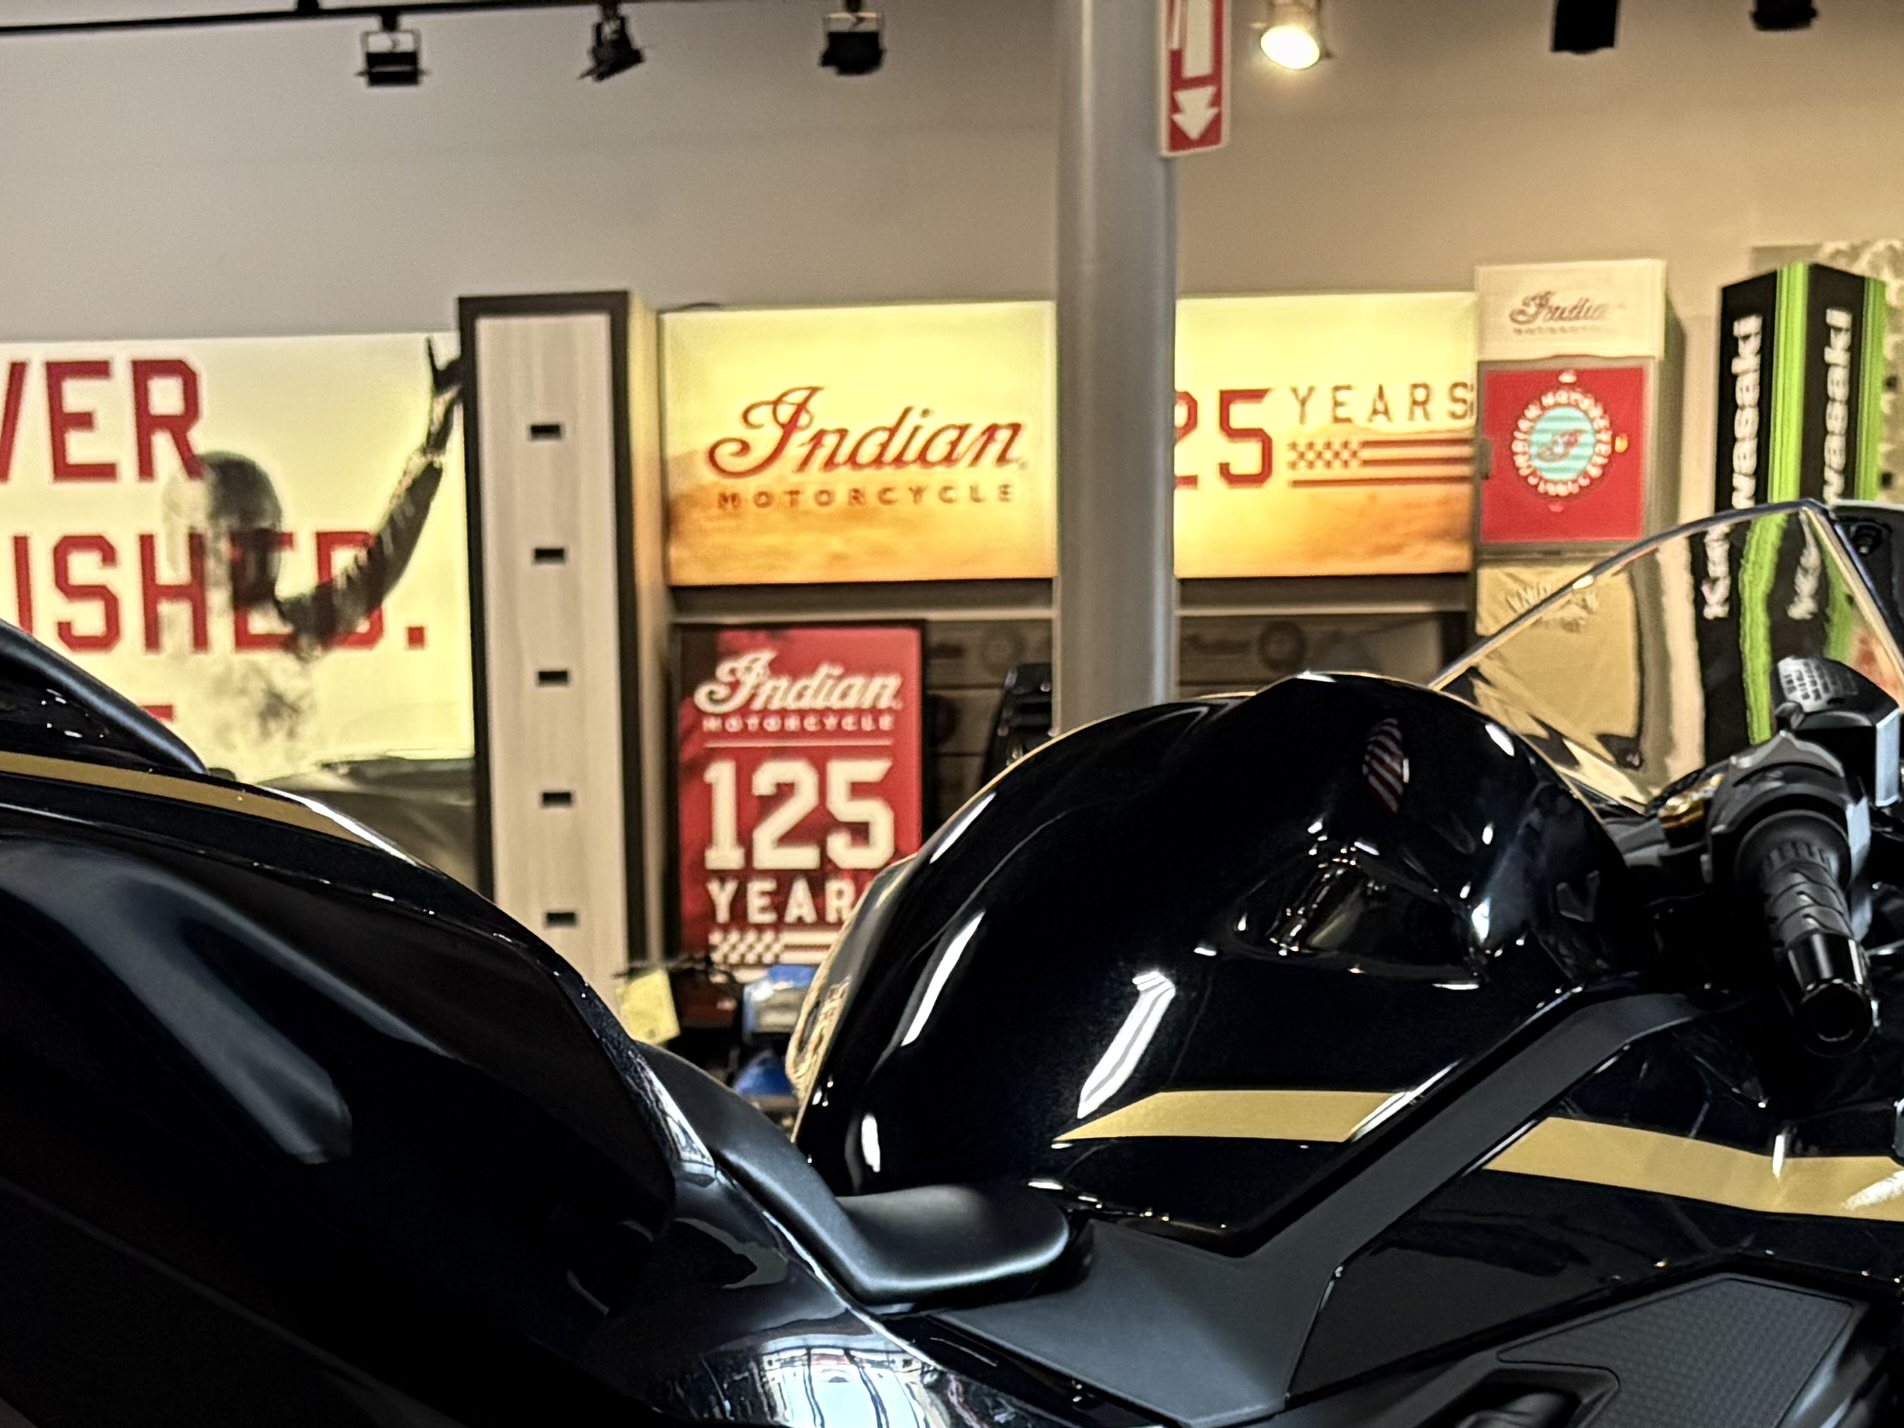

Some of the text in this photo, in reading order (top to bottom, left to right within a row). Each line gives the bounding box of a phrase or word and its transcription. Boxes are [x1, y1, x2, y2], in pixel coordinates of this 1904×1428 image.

[1290, 381, 1475, 424] YEARS
[707, 387, 1027, 479] Indian
[717, 484, 1014, 510] MOTORCYCLE
[694, 649, 904, 713] Indian
[702, 715, 894, 733] MOTORCYCLE
[704, 757, 895, 870] 125
[706, 876, 859, 925] YEAR
